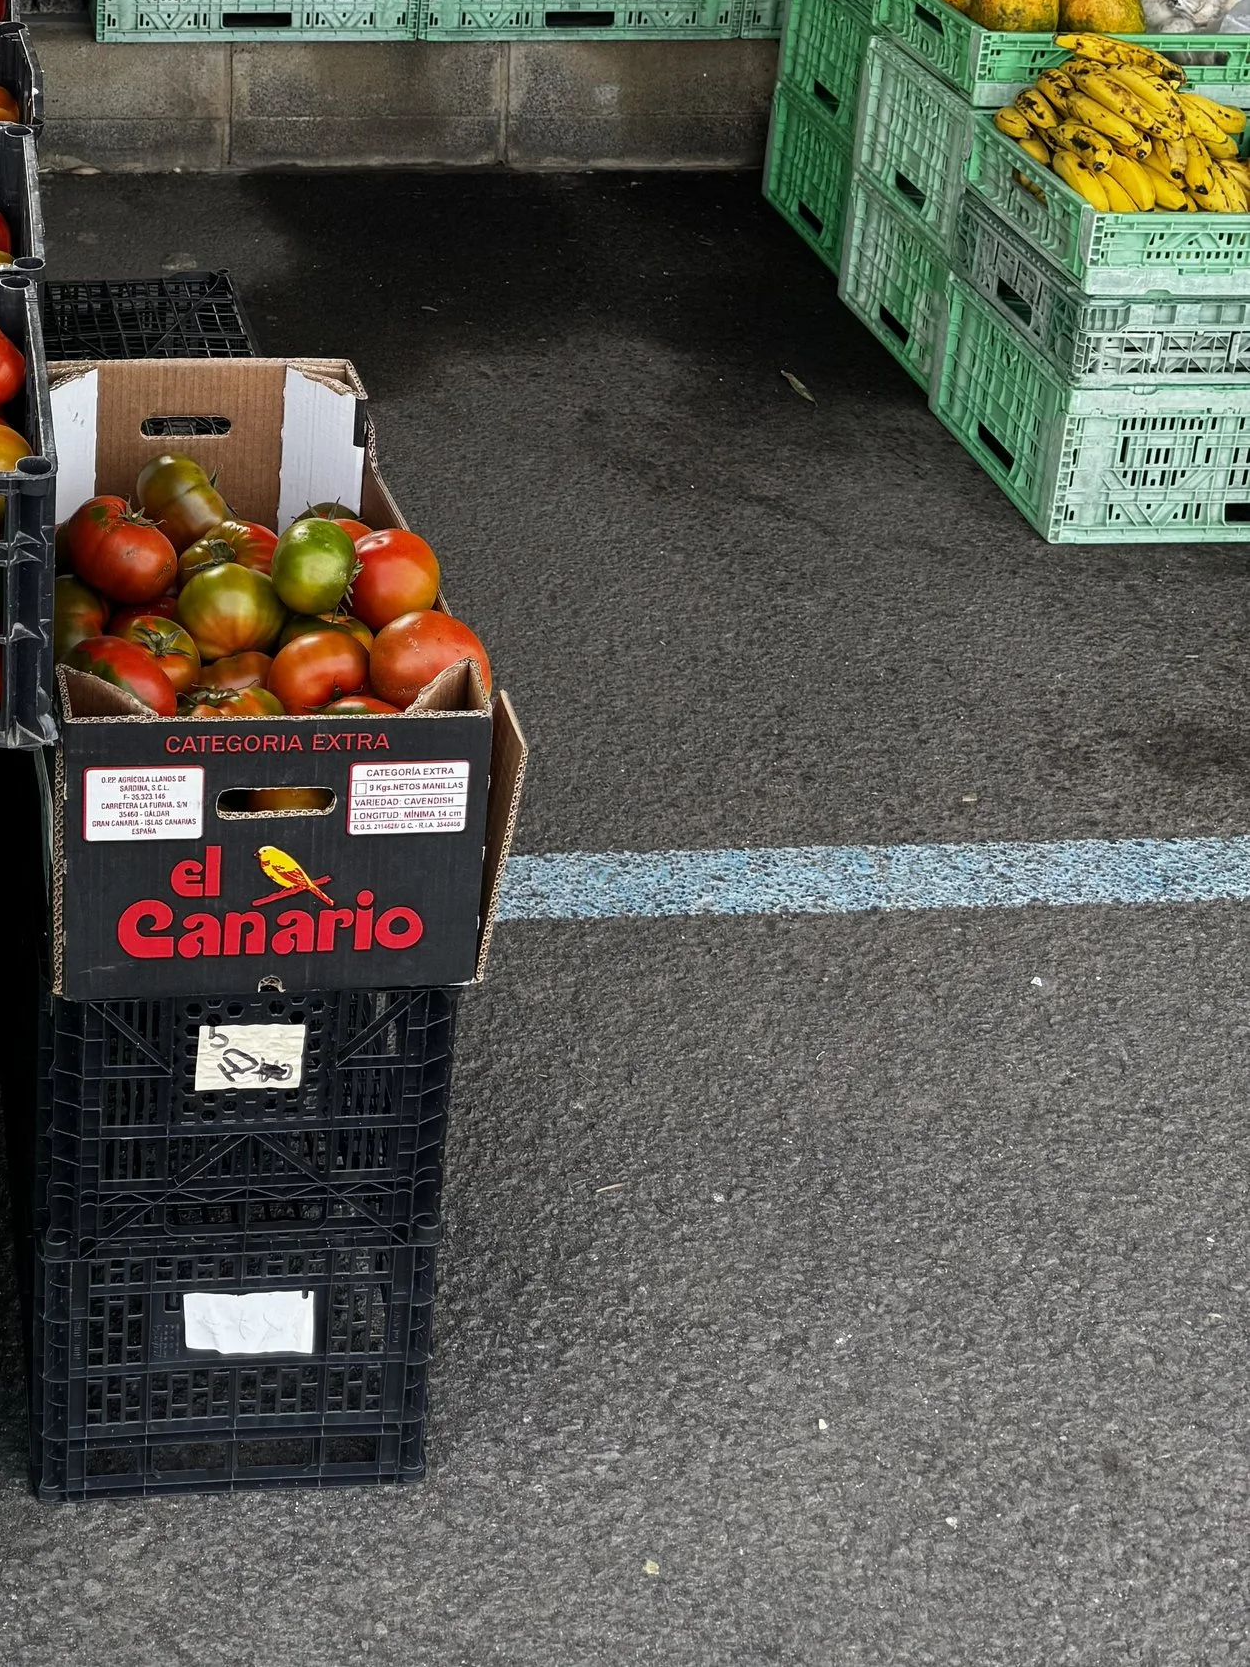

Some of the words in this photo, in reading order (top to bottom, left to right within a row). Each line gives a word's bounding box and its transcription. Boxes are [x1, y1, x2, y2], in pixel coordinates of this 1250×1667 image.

[165, 734, 304, 754] CATEGORIA
[312, 732, 391, 751] EXTRA
[366, 767, 422, 777] CATEGORÍA
[423, 767, 455, 776] EXTRA
[118, 775, 150, 784] AGRÍCOLA
[151, 775, 177, 783] LLANOS
[369, 784, 375, 792] 9
[422, 781, 464, 790] MANILLAS
[101, 801, 139, 810] CARRETERA
[139, 801, 148, 809] LA
[176, 800, 188, 808] S/N
[354, 798, 403, 807] VARIEDAD:
[404, 796, 454, 806] CAVENDISH
[354, 811, 402, 820] LONGITUD:
[403, 809, 436, 819] MÍNIMA
[92, 819, 110, 827] GRAN
[111, 819, 139, 827] CANARIA
[144, 818, 163, 826] ISLAS
[164, 817, 197, 825] CANARIAS
[131, 826, 157, 835] ESPAÑA
[170, 844, 222, 898] el
[116, 889, 425, 960] Canario
